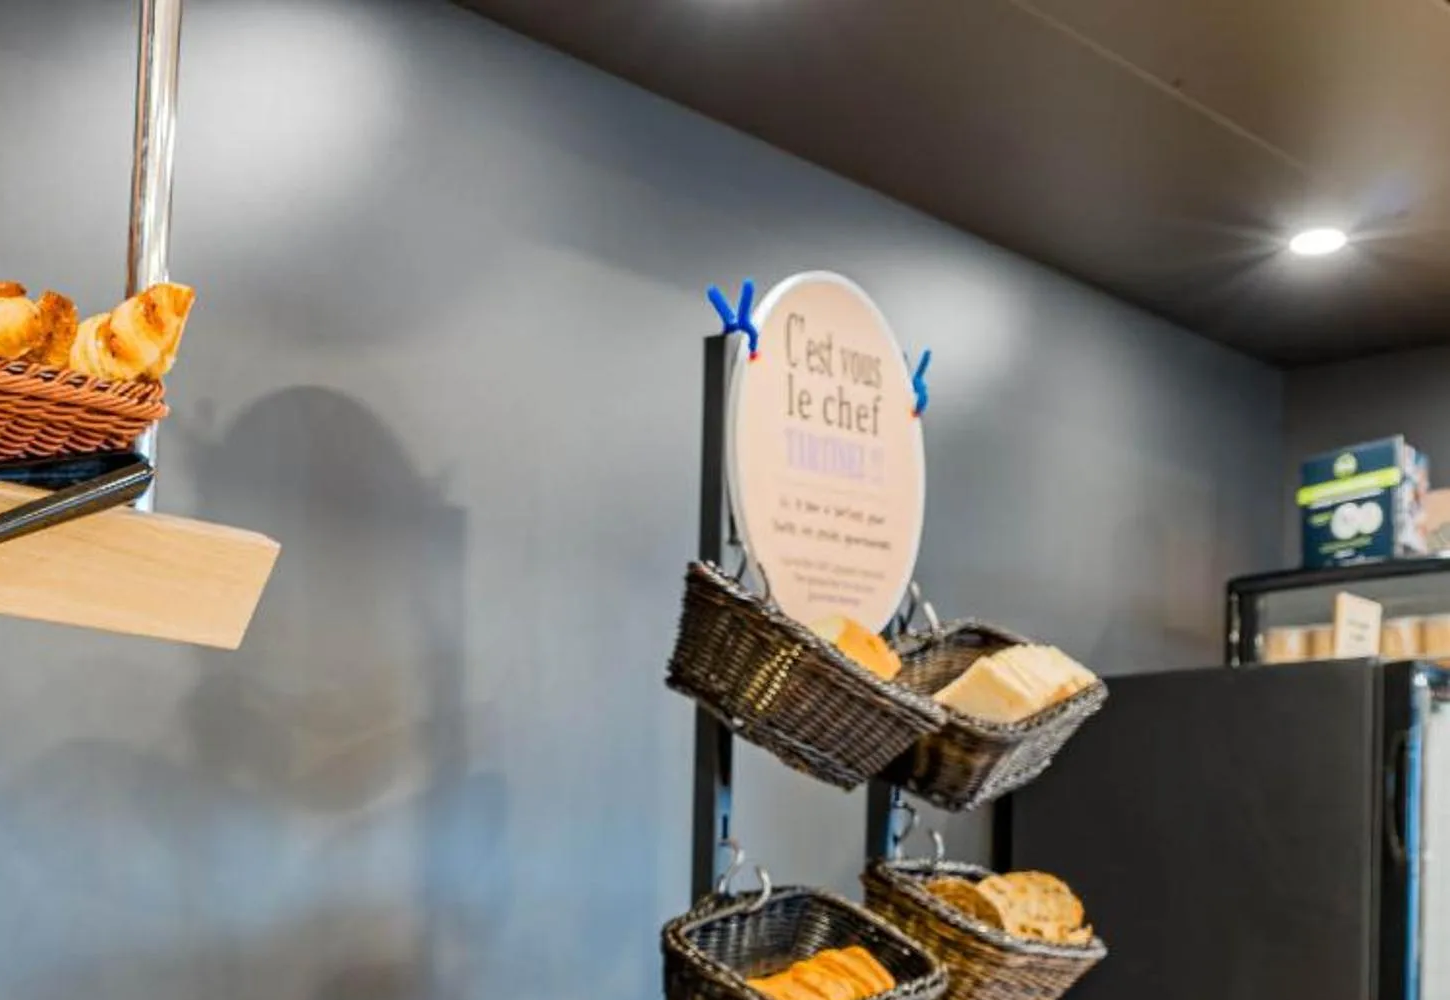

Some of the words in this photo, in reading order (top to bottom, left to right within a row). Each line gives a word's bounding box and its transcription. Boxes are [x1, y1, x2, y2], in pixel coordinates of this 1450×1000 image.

[785, 312, 834, 377] C'est
[787, 373, 812, 420] le
[822, 386, 882, 437] chef
